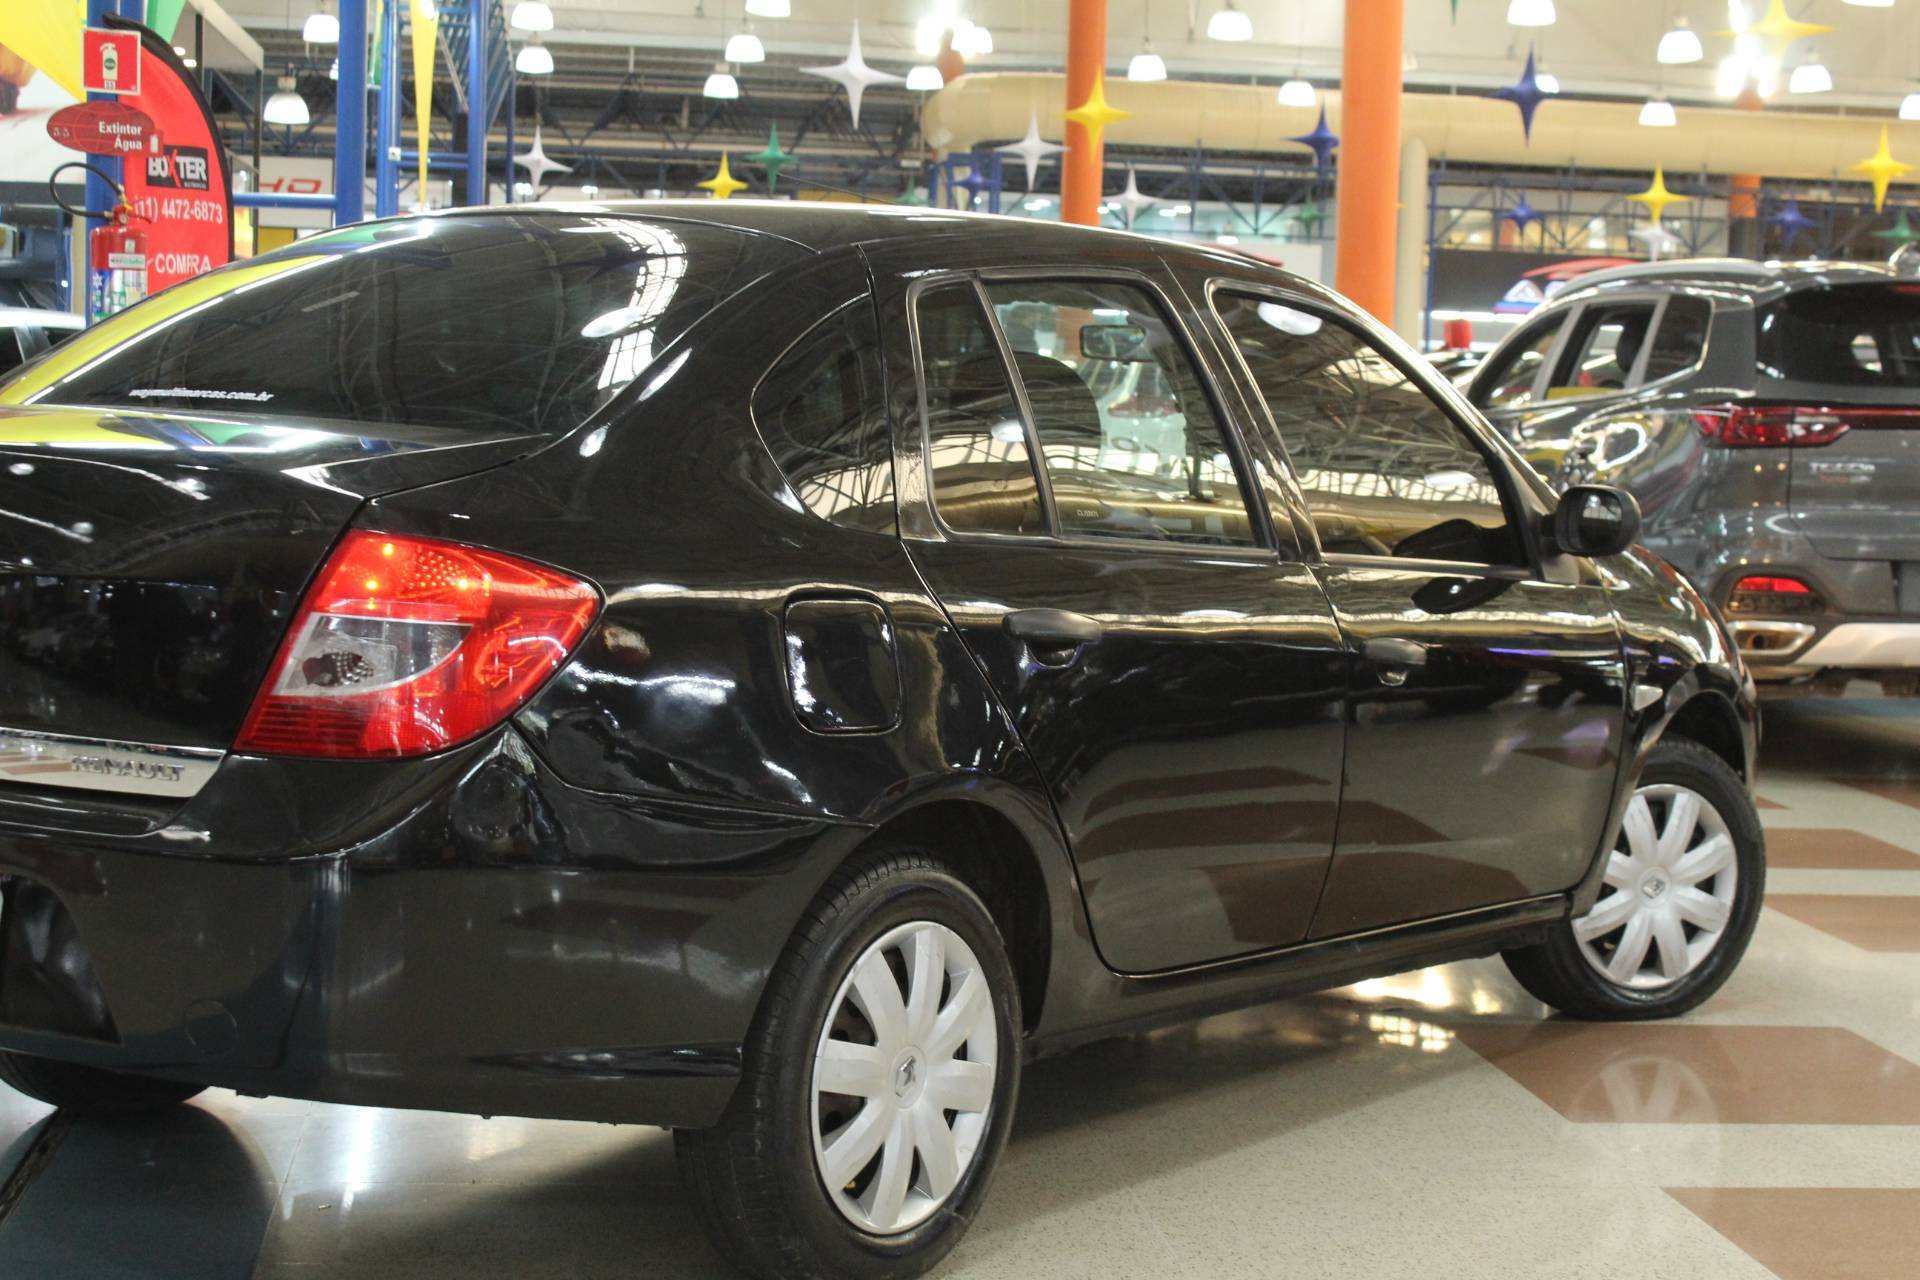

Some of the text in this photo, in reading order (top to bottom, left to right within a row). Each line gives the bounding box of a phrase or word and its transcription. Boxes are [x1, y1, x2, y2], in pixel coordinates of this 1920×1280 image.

[99, 121, 142, 135] Extintor
[114, 136, 142, 151] Água
[148, 150, 207, 185] BOXTER
[162, 199, 223, 224] 4472-6873
[155, 253, 212, 275] COMPRA
[72, 755, 185, 782] RENAULT
